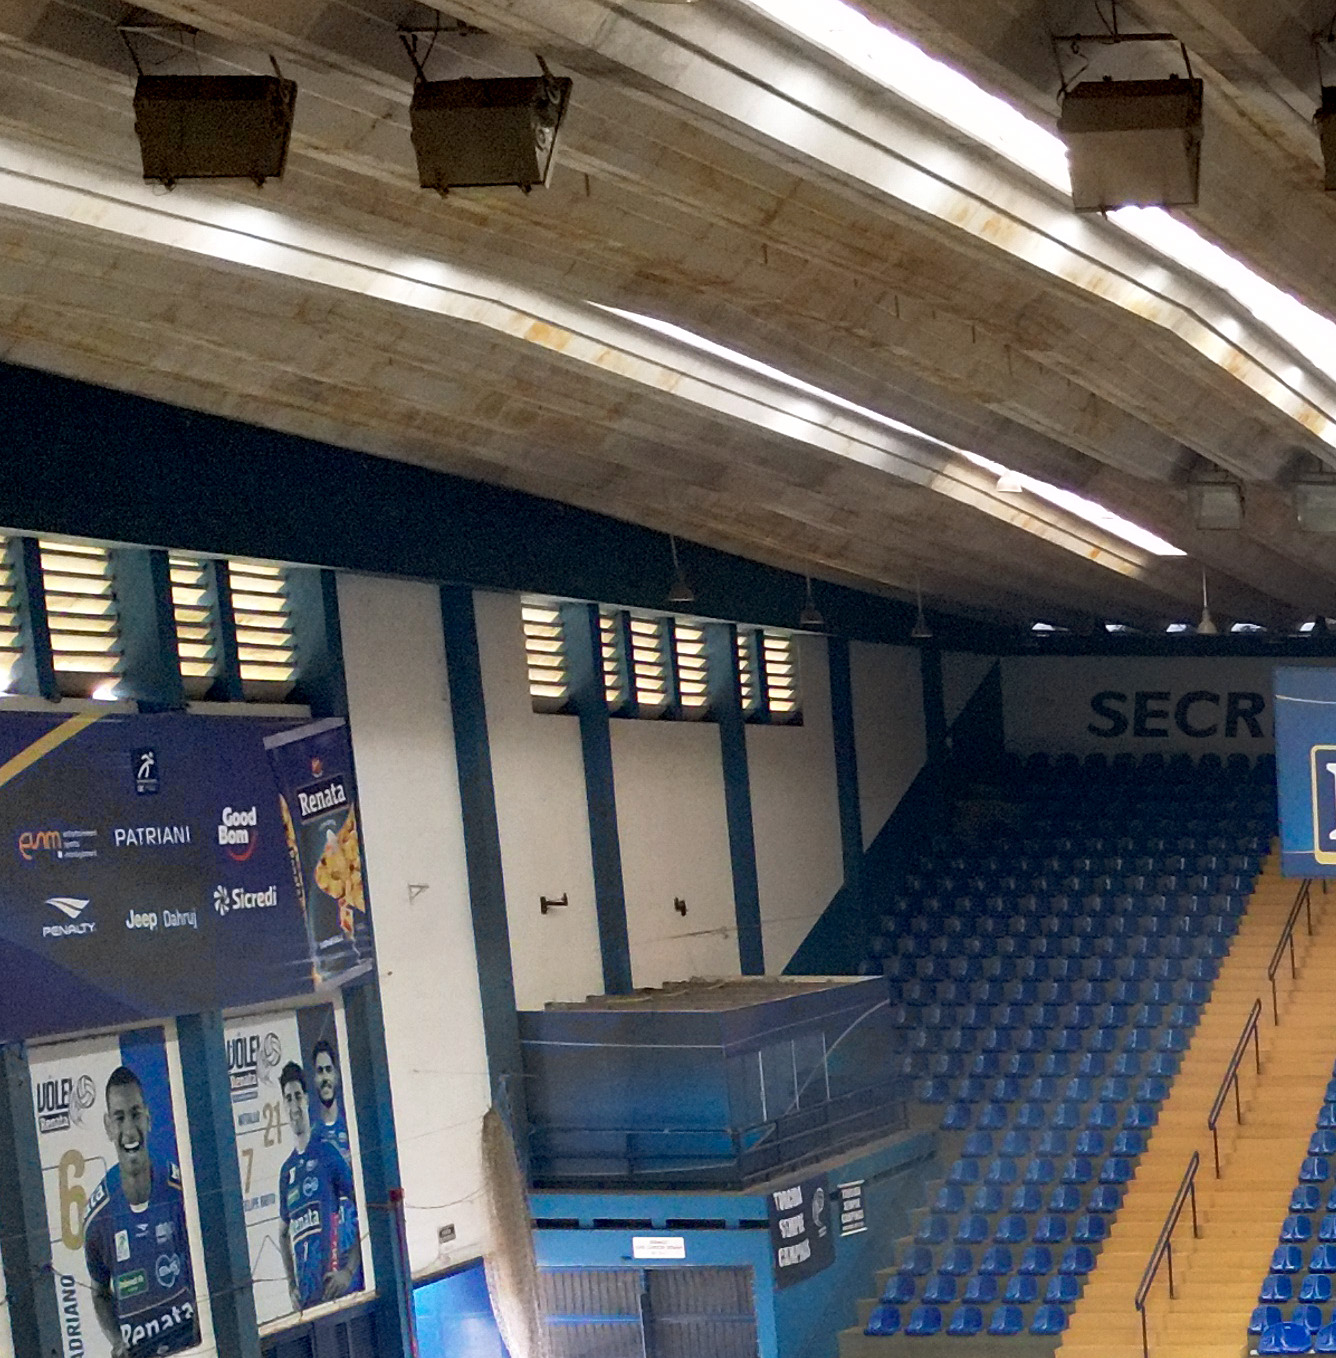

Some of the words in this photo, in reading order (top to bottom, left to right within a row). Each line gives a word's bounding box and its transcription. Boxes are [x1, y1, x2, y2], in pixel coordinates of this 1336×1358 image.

[1088, 691, 1275, 738] SECR
[298, 784, 346, 816] Renata
[222, 807, 257, 827] Good
[115, 826, 191, 846] PATRIANI
[217, 825, 249, 845] Bom
[232, 886, 277, 909] Sicredi
[42, 922, 96, 938] PENALTY
[126, 909, 157, 930] Jeep
[163, 909, 197, 930] Dahruj
[262, 1100, 283, 1149] 21
[241, 1148, 254, 1194] 7
[59, 1149, 87, 1251] 6
